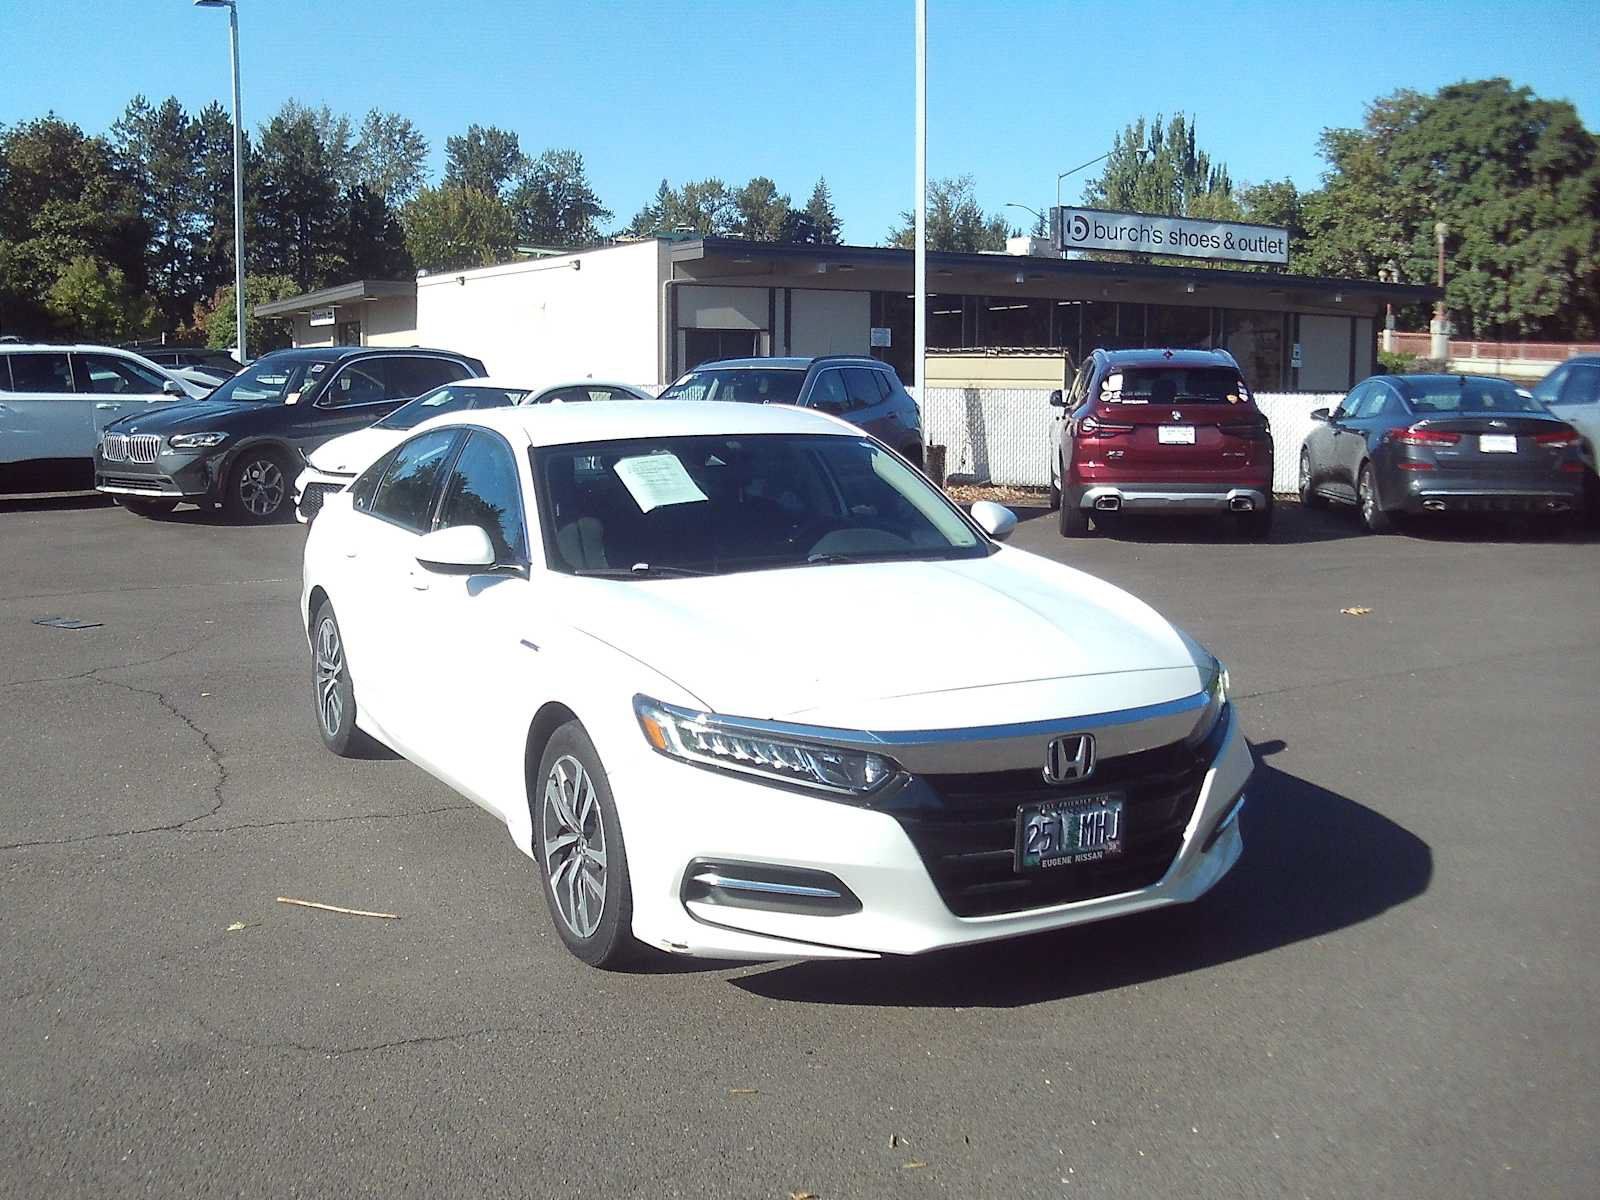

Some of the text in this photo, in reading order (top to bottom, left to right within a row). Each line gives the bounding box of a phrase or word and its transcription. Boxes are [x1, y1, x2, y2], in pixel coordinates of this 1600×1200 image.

[1094, 220, 1285, 255] burch's shoes & outlet
[1079, 808, 1121, 848] MHJ
[1042, 850, 1104, 869] EUGENE NISSAN
